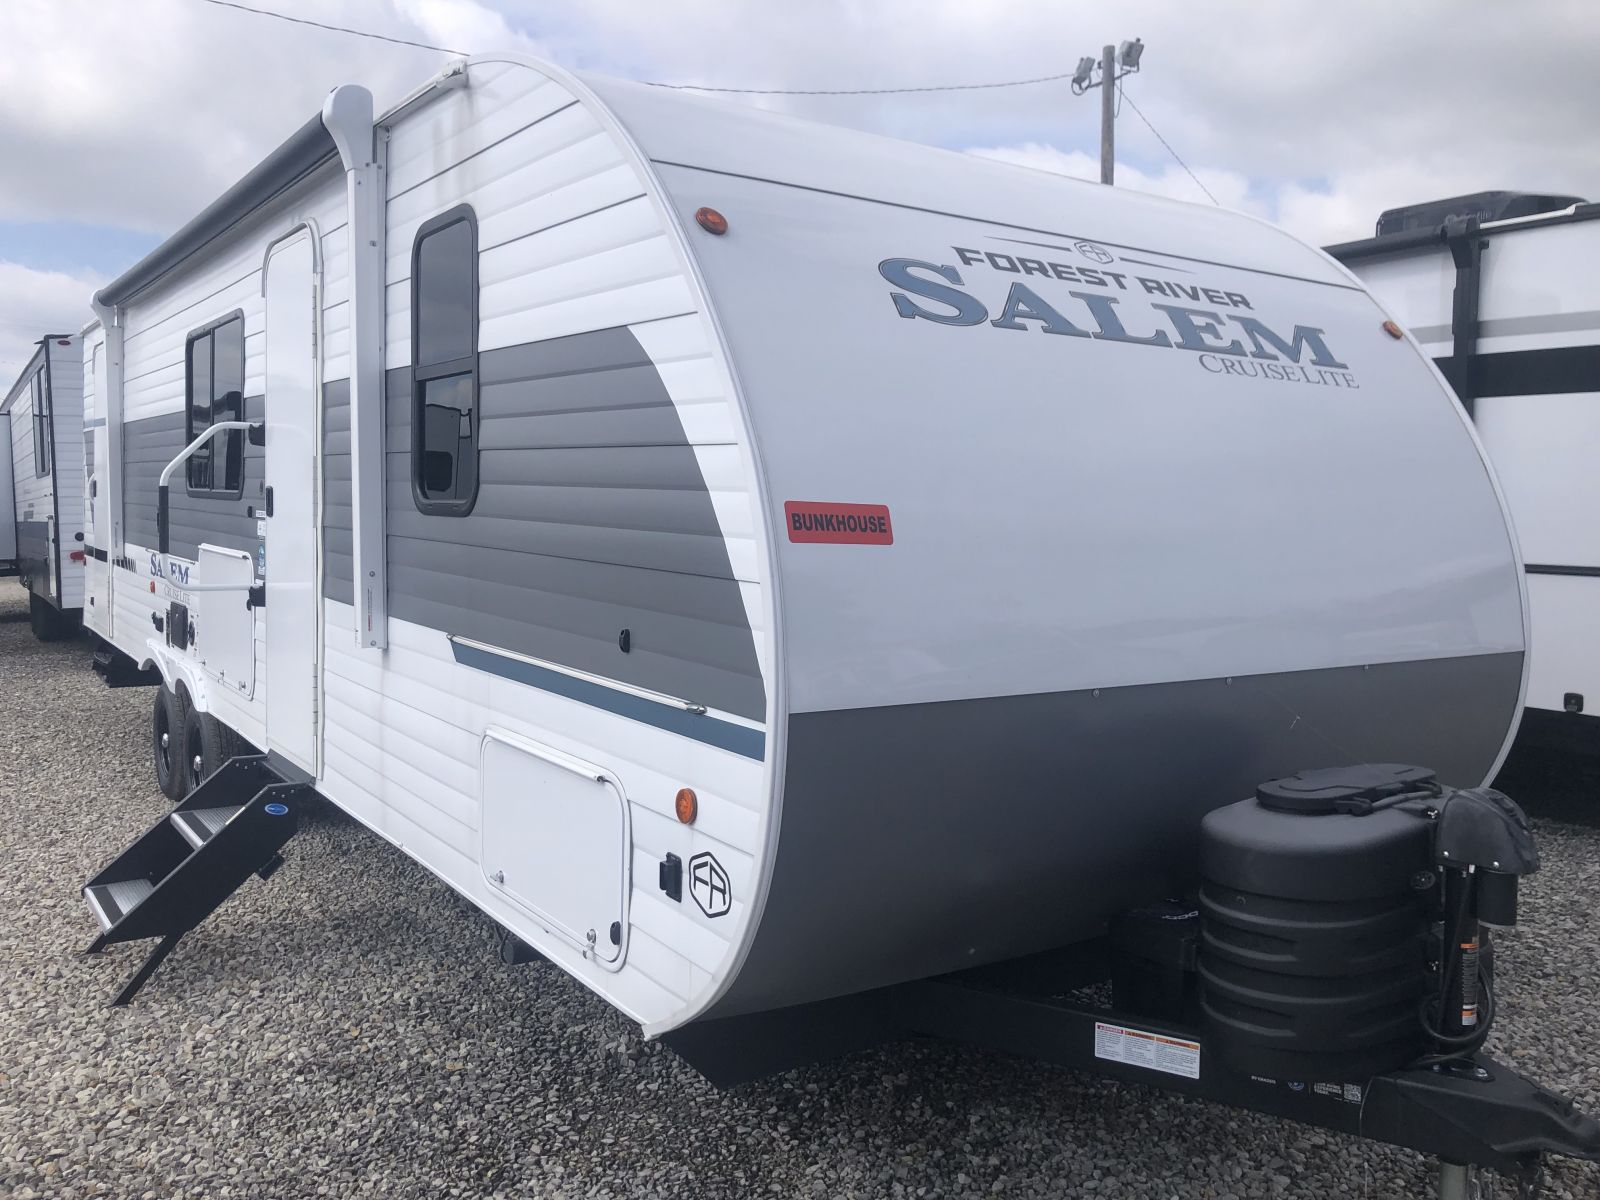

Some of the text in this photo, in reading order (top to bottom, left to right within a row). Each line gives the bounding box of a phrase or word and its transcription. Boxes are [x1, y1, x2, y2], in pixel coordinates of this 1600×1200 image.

[951, 245, 1256, 310] FOREST RIVER
[877, 256, 1350, 371] SALEM
[791, 513, 888, 533] BUNKHOUSE
[150, 552, 190, 585] SAEM
